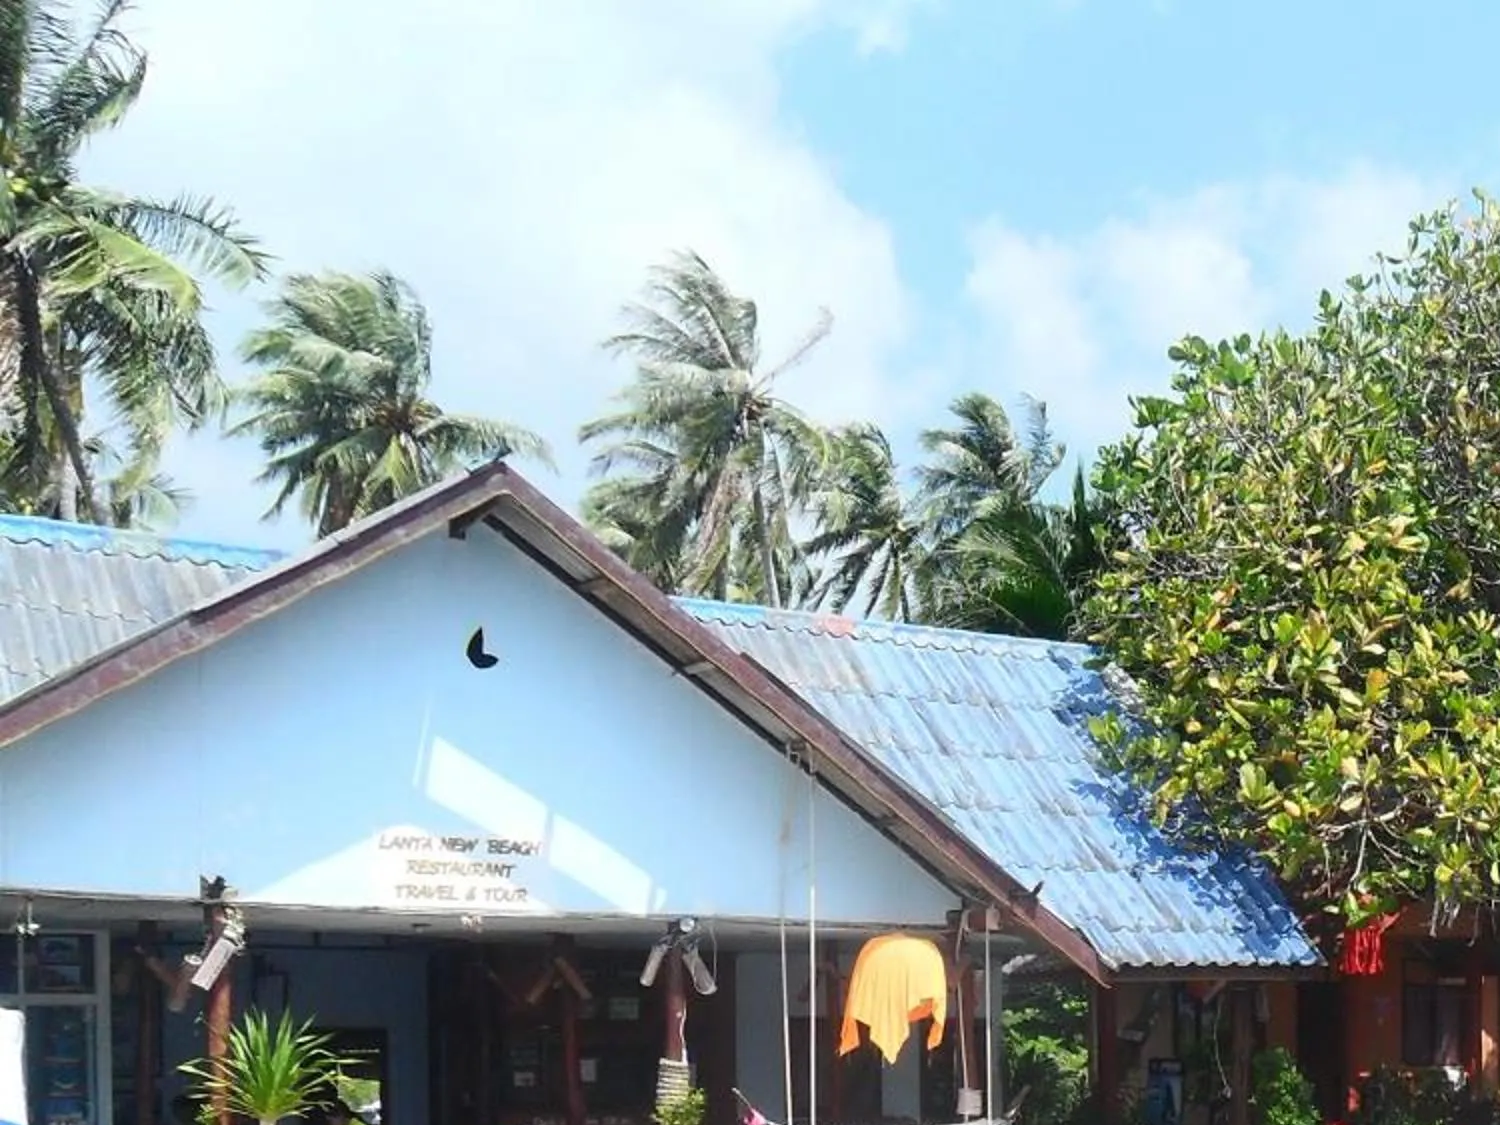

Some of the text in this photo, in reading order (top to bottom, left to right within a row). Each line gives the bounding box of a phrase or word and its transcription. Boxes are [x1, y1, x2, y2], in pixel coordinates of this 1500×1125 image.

[378, 833, 542, 856] LANTA NEW BEACH
[405, 858, 517, 879] RESTAURANT
[394, 884, 460, 901] TRAVEL
[483, 886, 529, 903] TOUR
